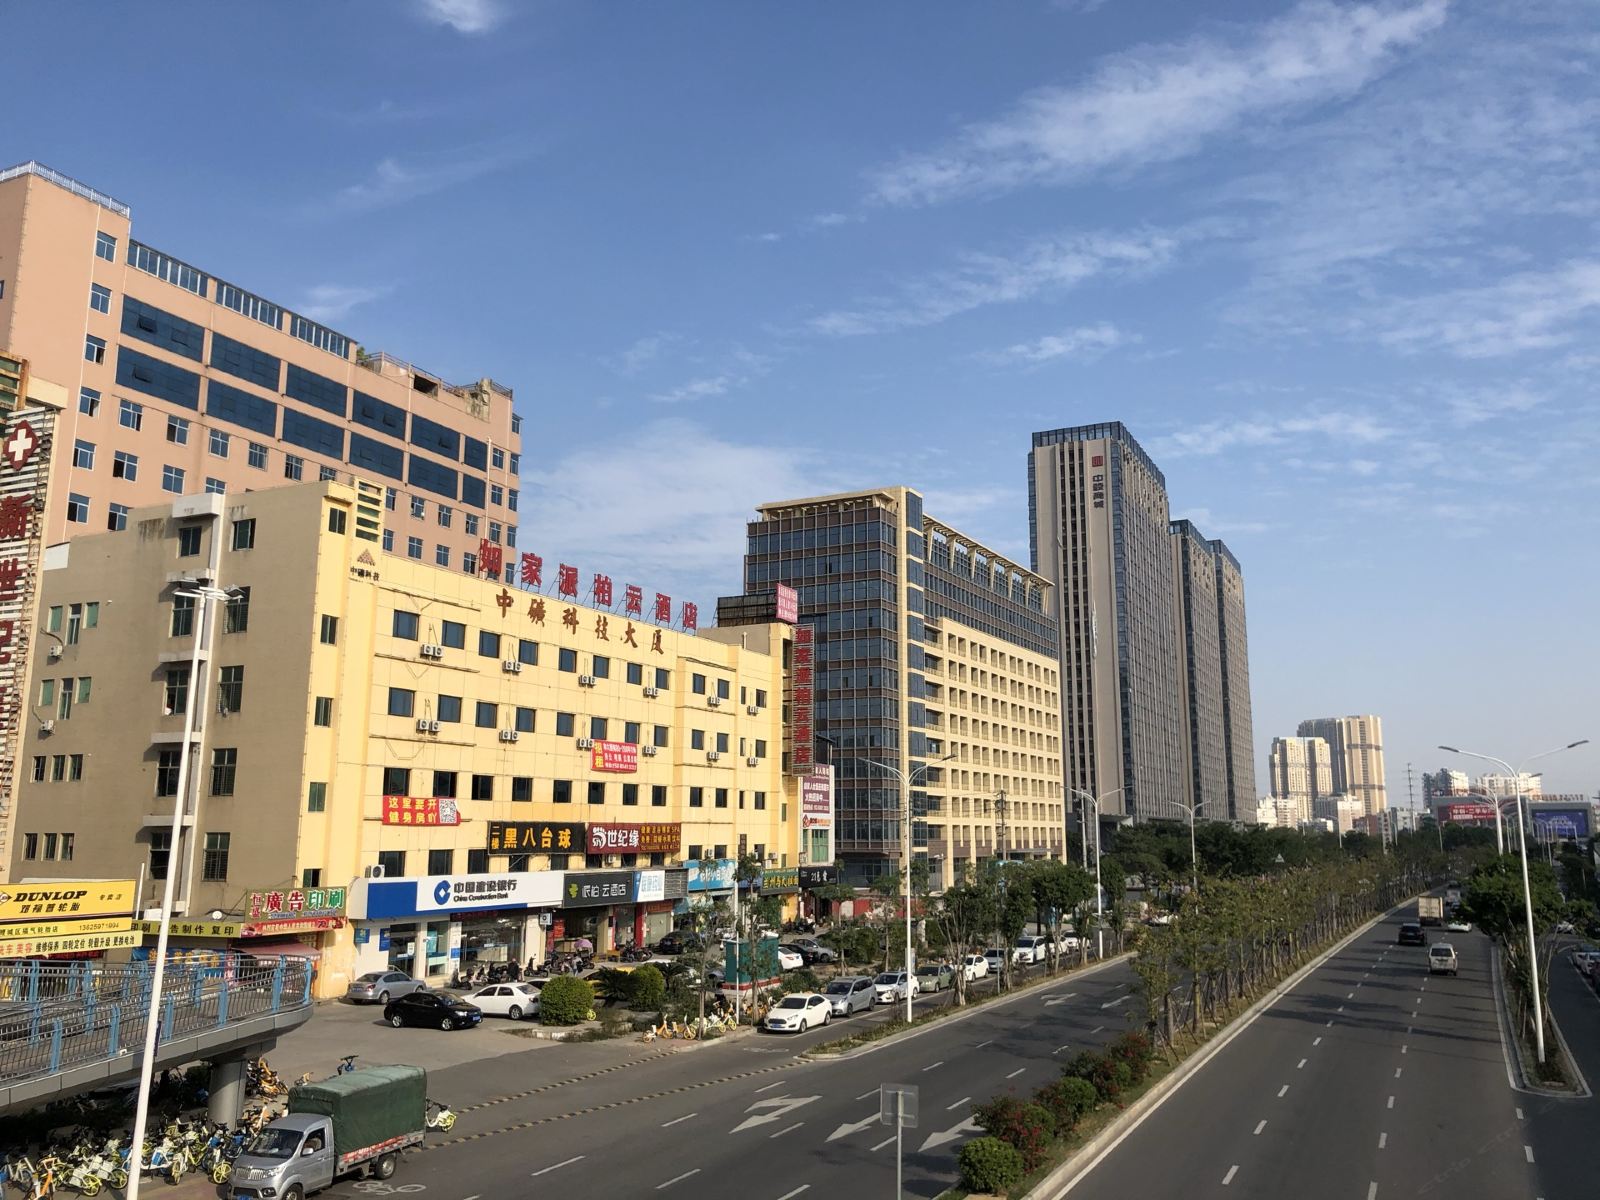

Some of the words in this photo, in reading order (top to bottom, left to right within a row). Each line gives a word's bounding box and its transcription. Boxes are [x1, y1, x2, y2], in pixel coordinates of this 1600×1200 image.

[389, 797, 437, 810] 这里要开
[491, 825, 500, 849] 二楼
[503, 827, 572, 849] 黑八台球
[607, 829, 639, 847] 世纪缘
[454, 879, 517, 894] 中国建设银行
[13, 890, 88, 903] DUNLOP
[158, 924, 204, 934] 告制作
